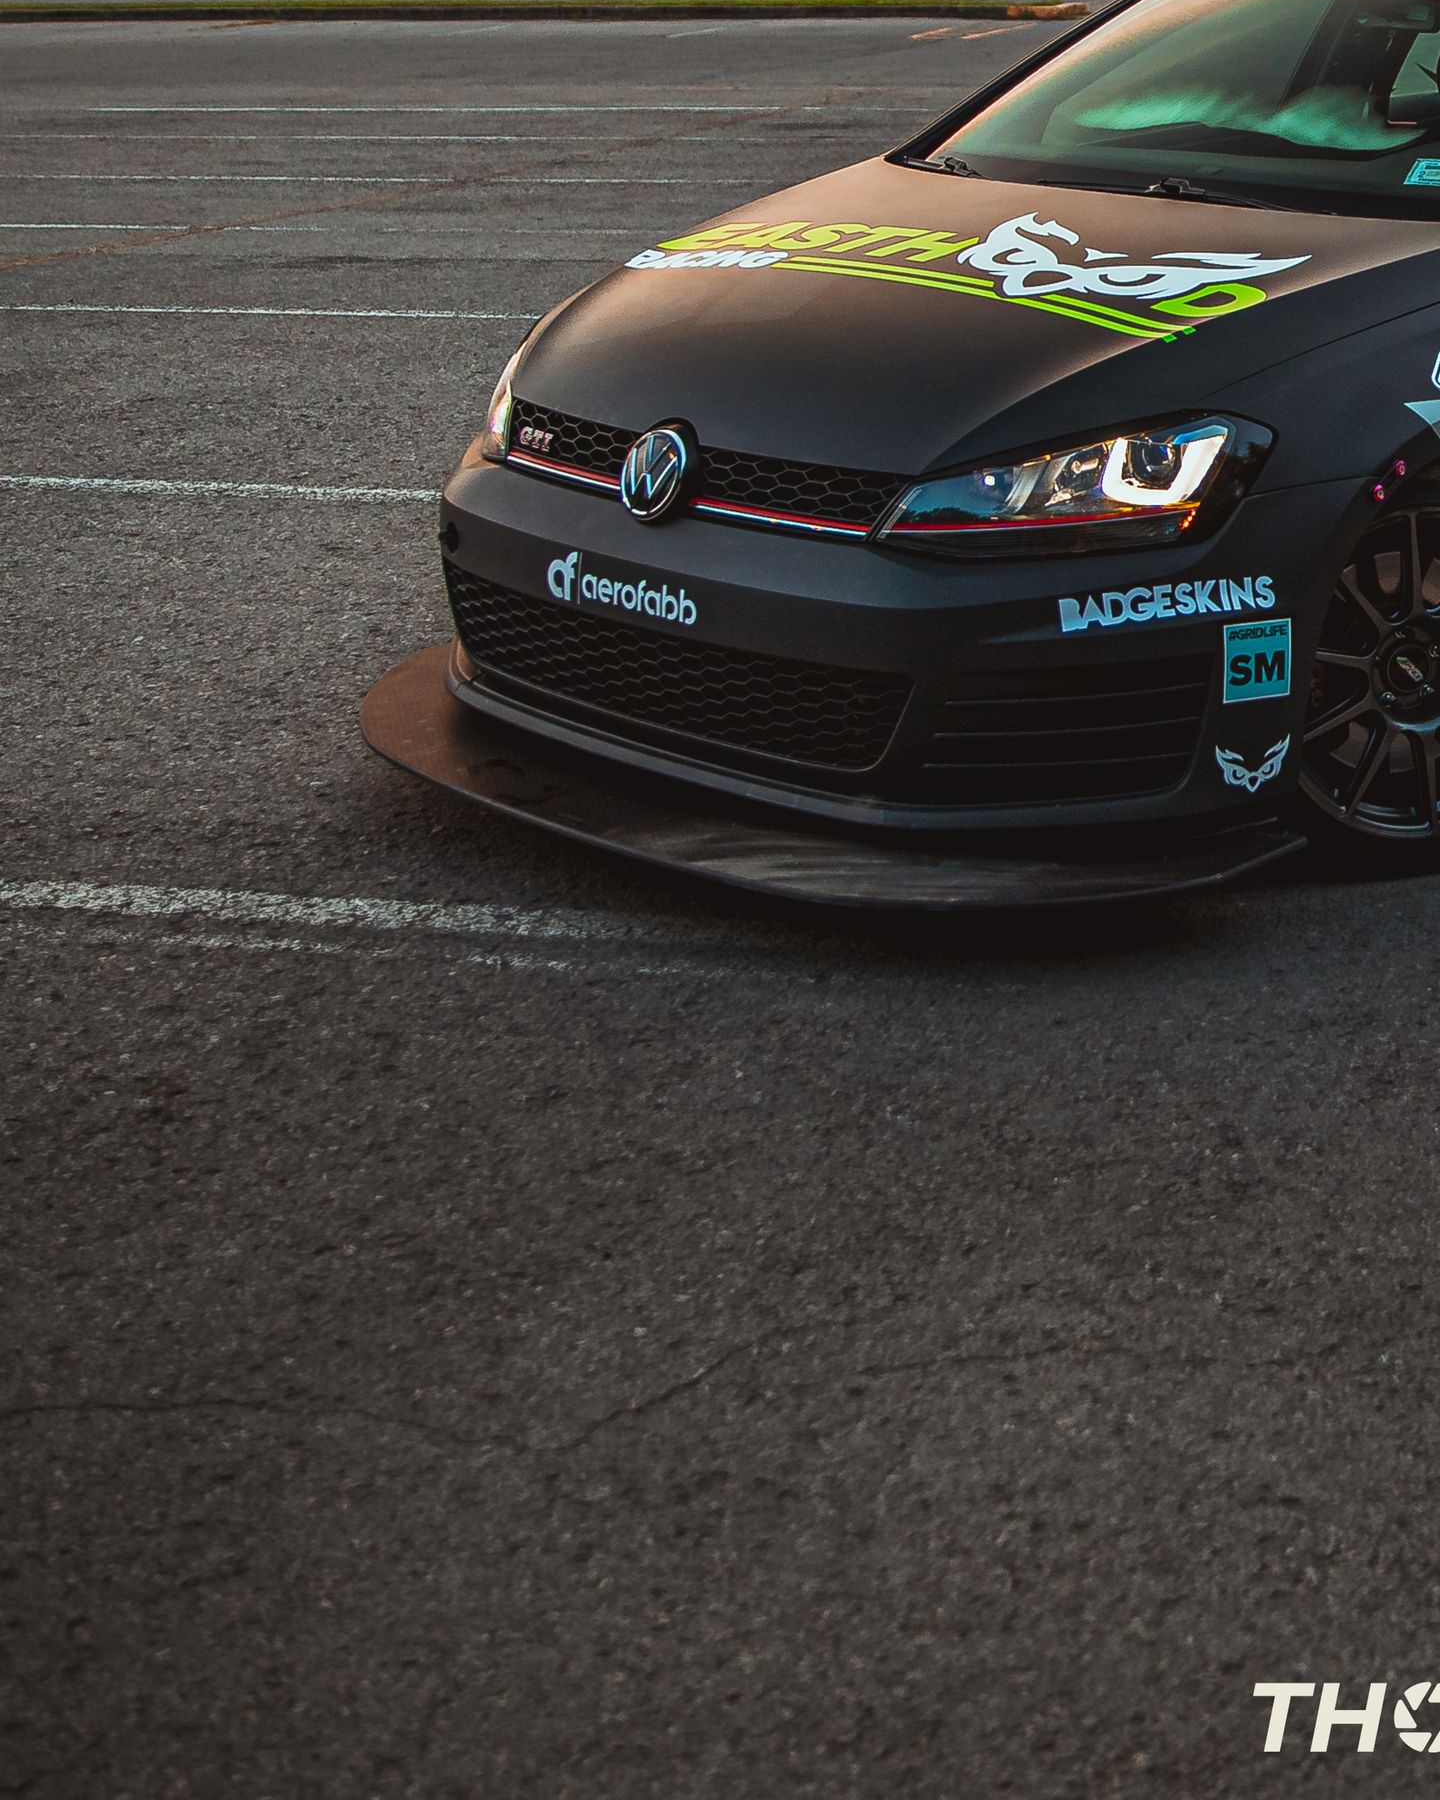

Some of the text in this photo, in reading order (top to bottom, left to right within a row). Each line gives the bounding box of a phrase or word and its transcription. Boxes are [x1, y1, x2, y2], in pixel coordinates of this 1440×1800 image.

[624, 249, 789, 269] RACING
[520, 426, 554, 451] GTI
[581, 573, 697, 625] aerofabb
[1058, 575, 1276, 632] BADGESKINS
[1227, 624, 1288, 642] #GRIDLIFE
[1228, 650, 1286, 687] SM
